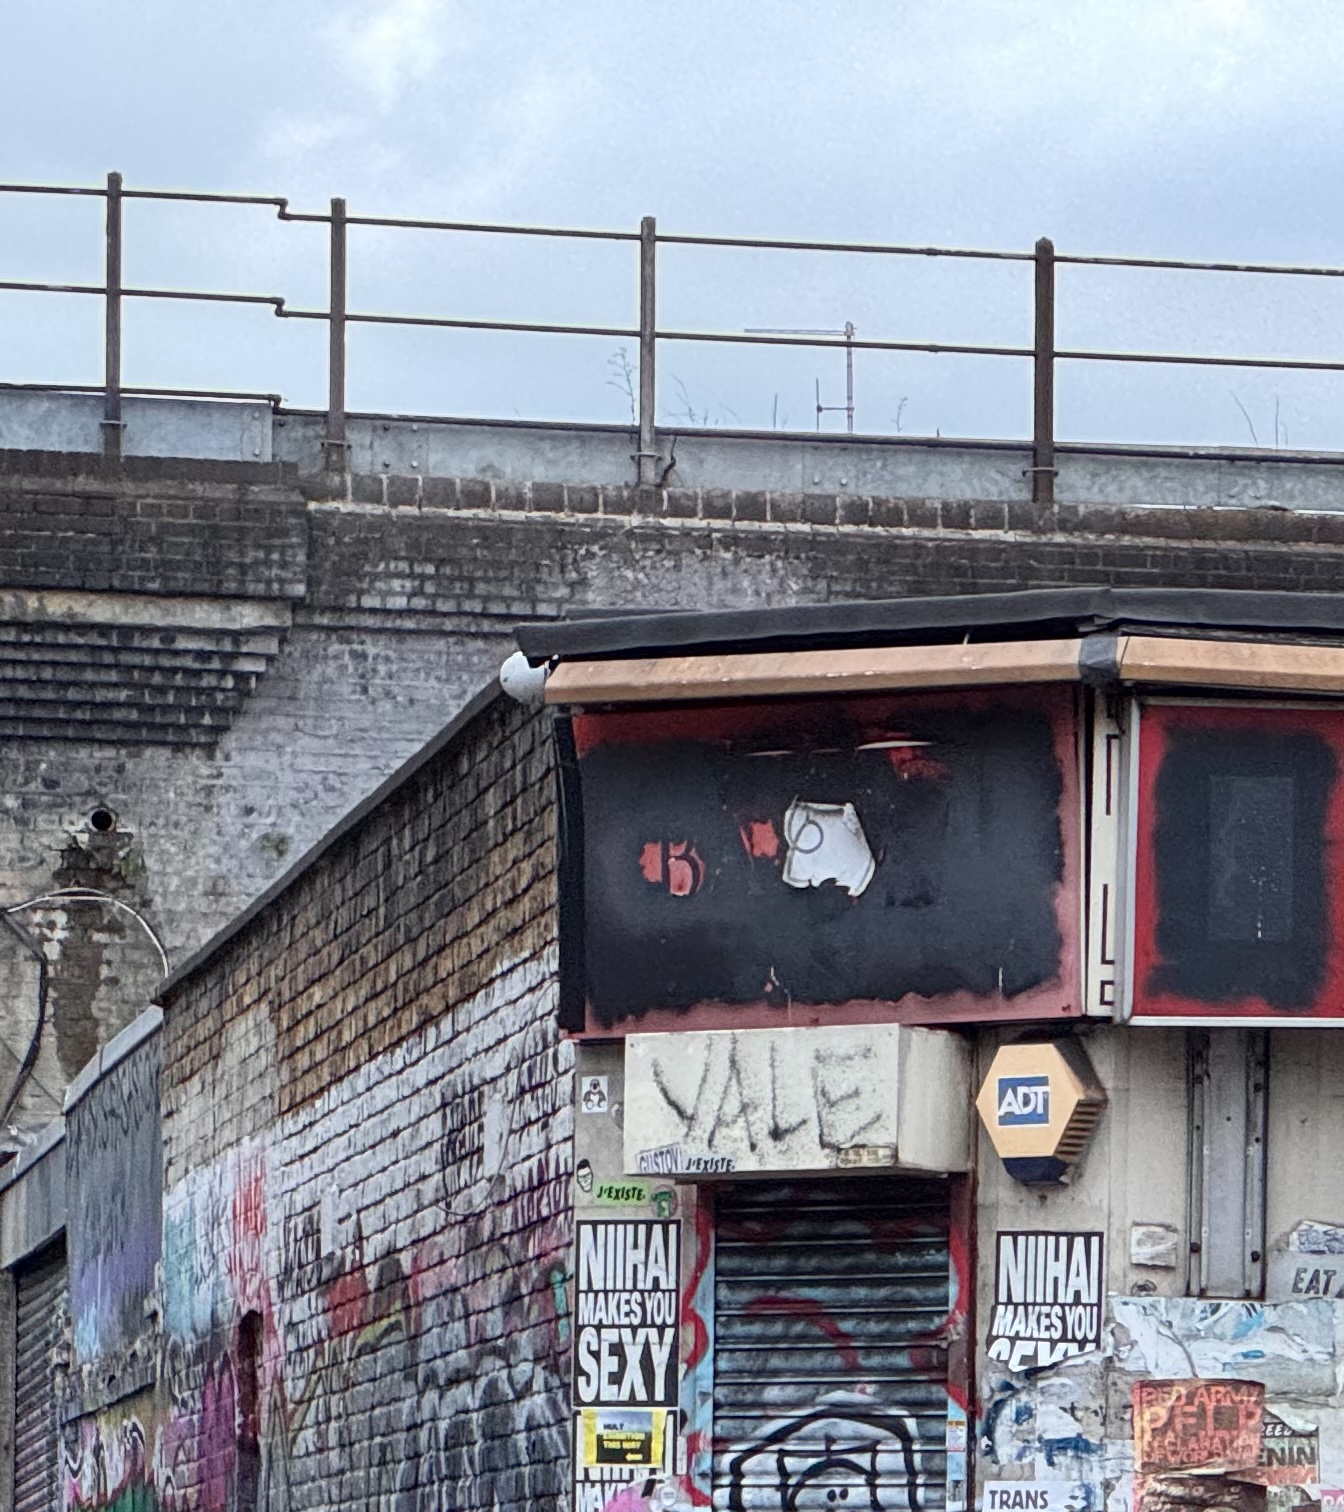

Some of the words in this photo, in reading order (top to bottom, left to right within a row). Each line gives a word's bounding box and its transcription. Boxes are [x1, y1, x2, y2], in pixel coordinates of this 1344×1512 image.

[998, 1086, 1051, 1116] ADT
[579, 1224, 678, 1291] NIIHAI
[1291, 1267, 1337, 1296] EAT
[578, 1292, 643, 1326] MAKES
[643, 1291, 677, 1326] YOU
[992, 1304, 1063, 1339] MAKES
[1063, 1304, 1098, 1337] YOU
[577, 1326, 676, 1403] SEXY
[989, 1489, 1049, 1510] TRANS
